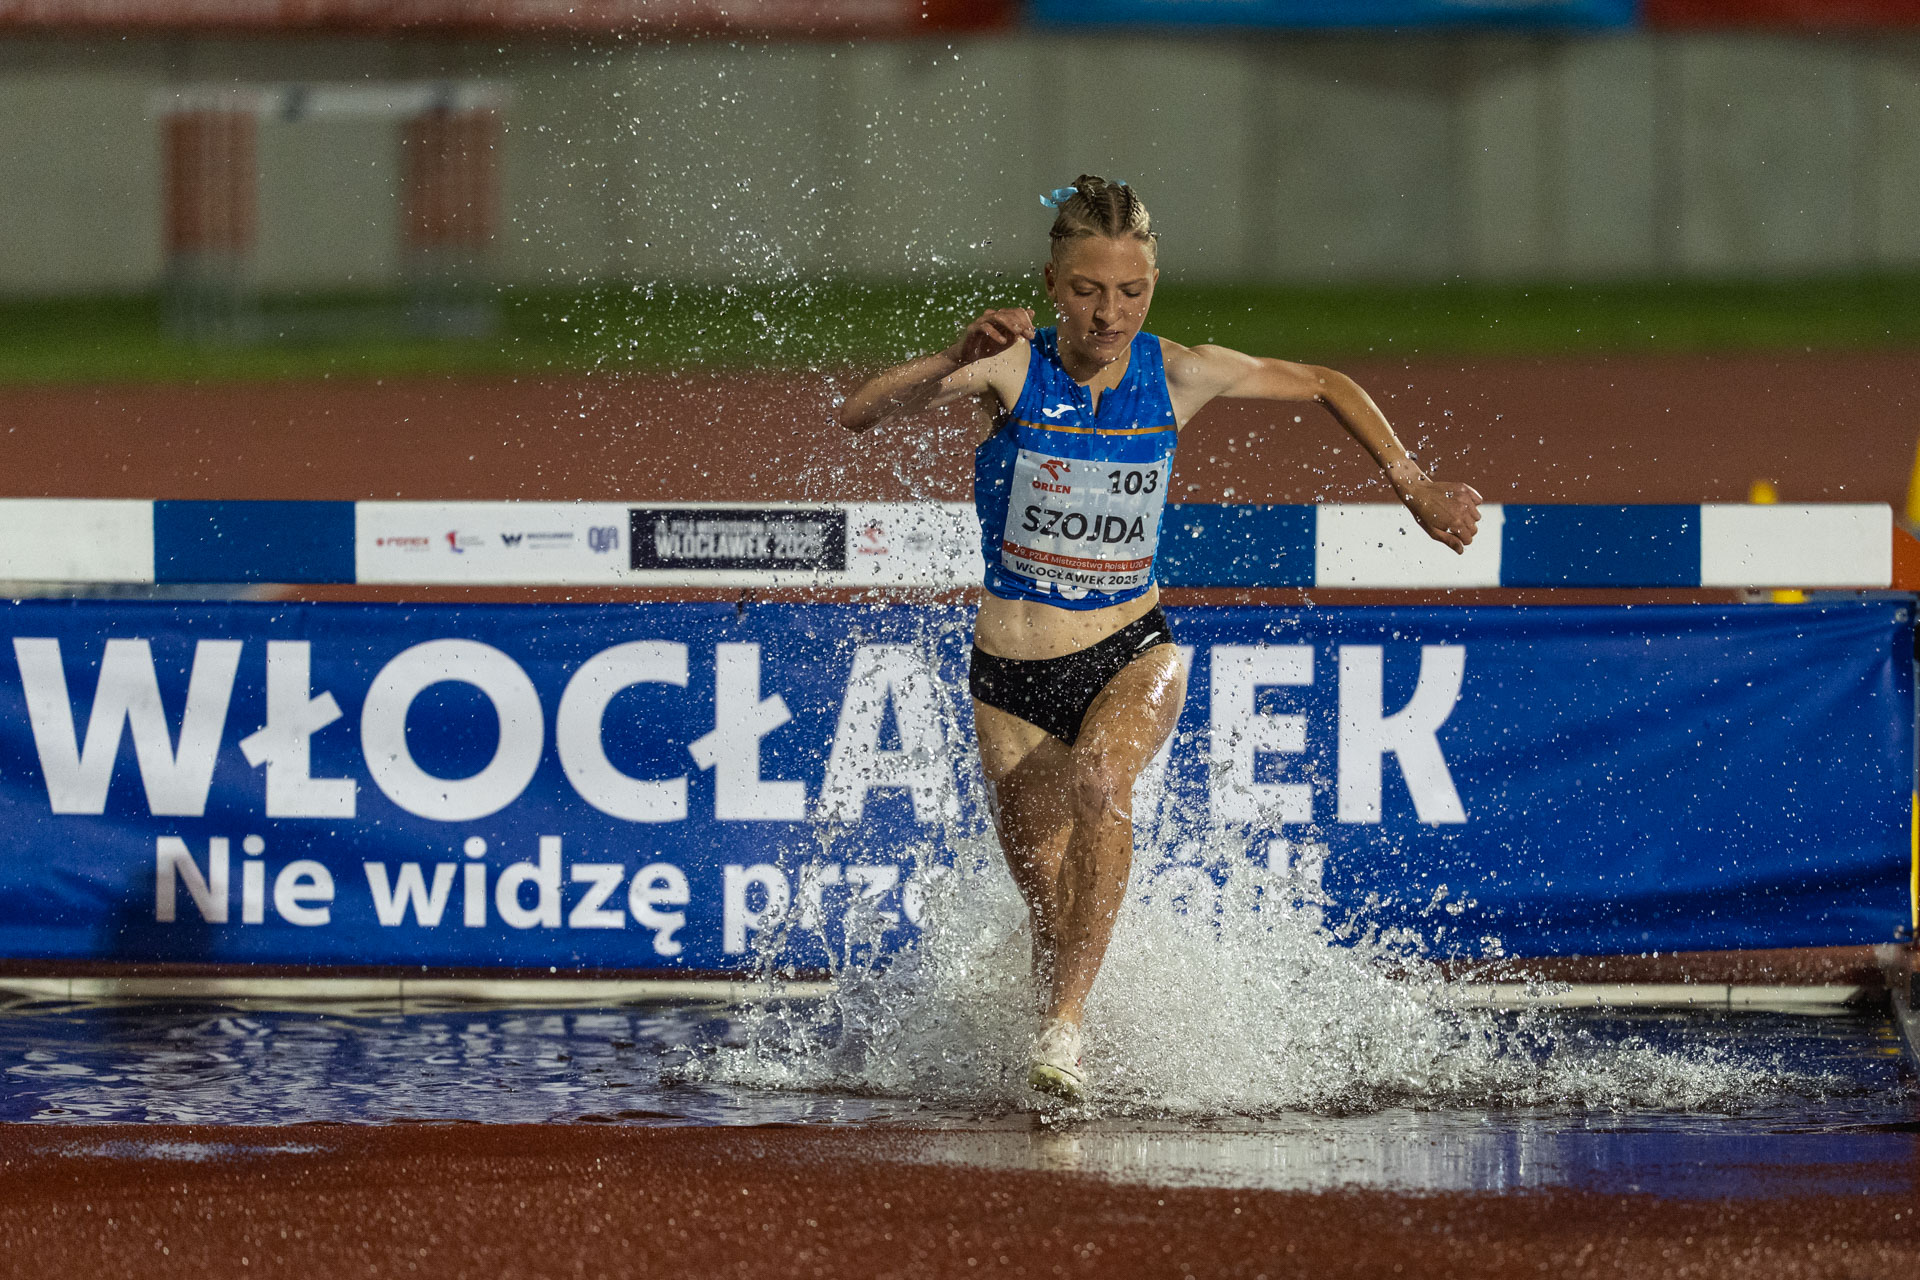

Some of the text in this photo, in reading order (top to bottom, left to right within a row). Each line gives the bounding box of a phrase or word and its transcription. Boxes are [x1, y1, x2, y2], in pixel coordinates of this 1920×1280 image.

[1031, 480, 1072, 495] ORLEN
[1106, 469, 1159, 496] 103
[1021, 504, 1145, 545] SZOJDA
[1015, 560, 1139, 585] WŁOCŁAWEK 2025
[1029, 551, 1049, 562] PZLA
[1050, 556, 1103, 569] Mistrzostwa
[1129, 560, 1144, 569] U20
[12, 636, 1468, 824] WŁOCŁAEK
[154, 834, 336, 927] Nie
[363, 834, 691, 957] widzę
